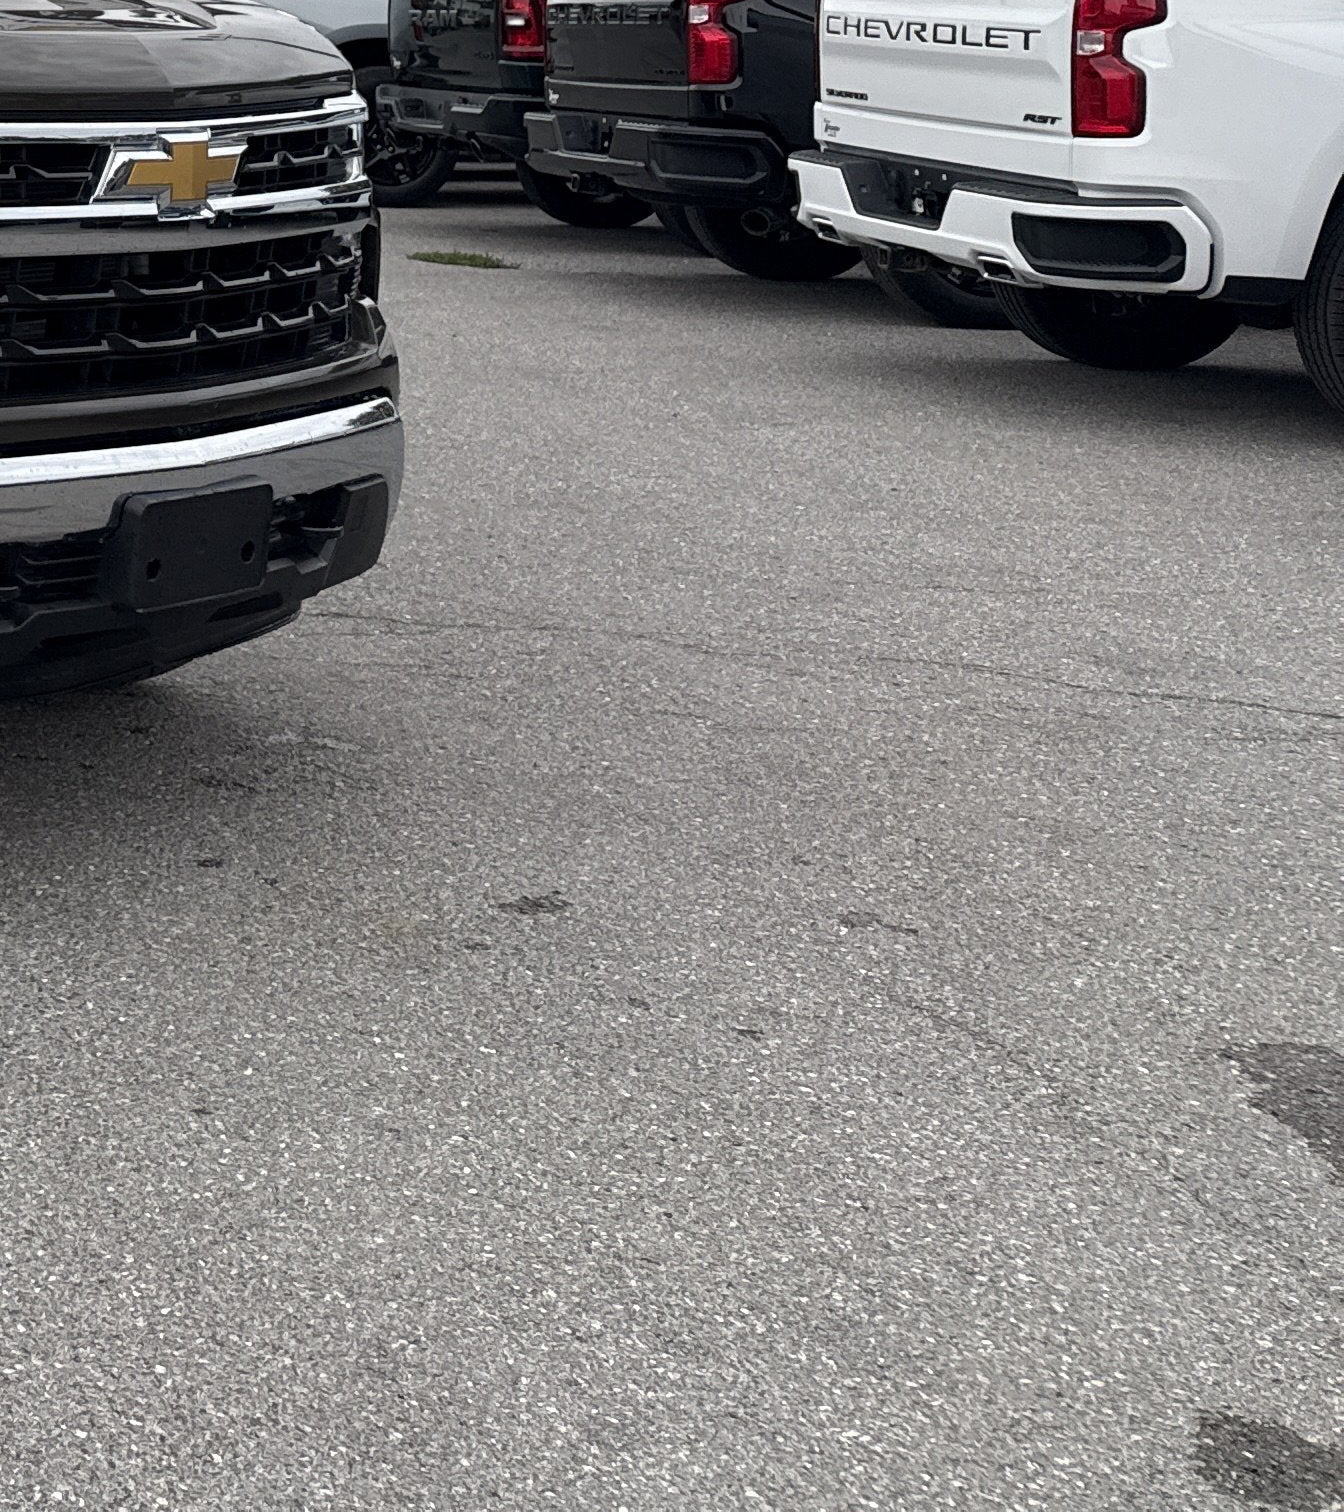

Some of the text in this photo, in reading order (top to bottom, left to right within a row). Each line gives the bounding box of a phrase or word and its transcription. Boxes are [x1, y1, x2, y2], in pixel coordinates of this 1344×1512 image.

[408, 9, 459, 28] RAM
[547, 7, 671, 25] CHEVROLET
[825, 14, 1042, 51] CHEVROLET
[1022, 113, 1062, 126] RST
